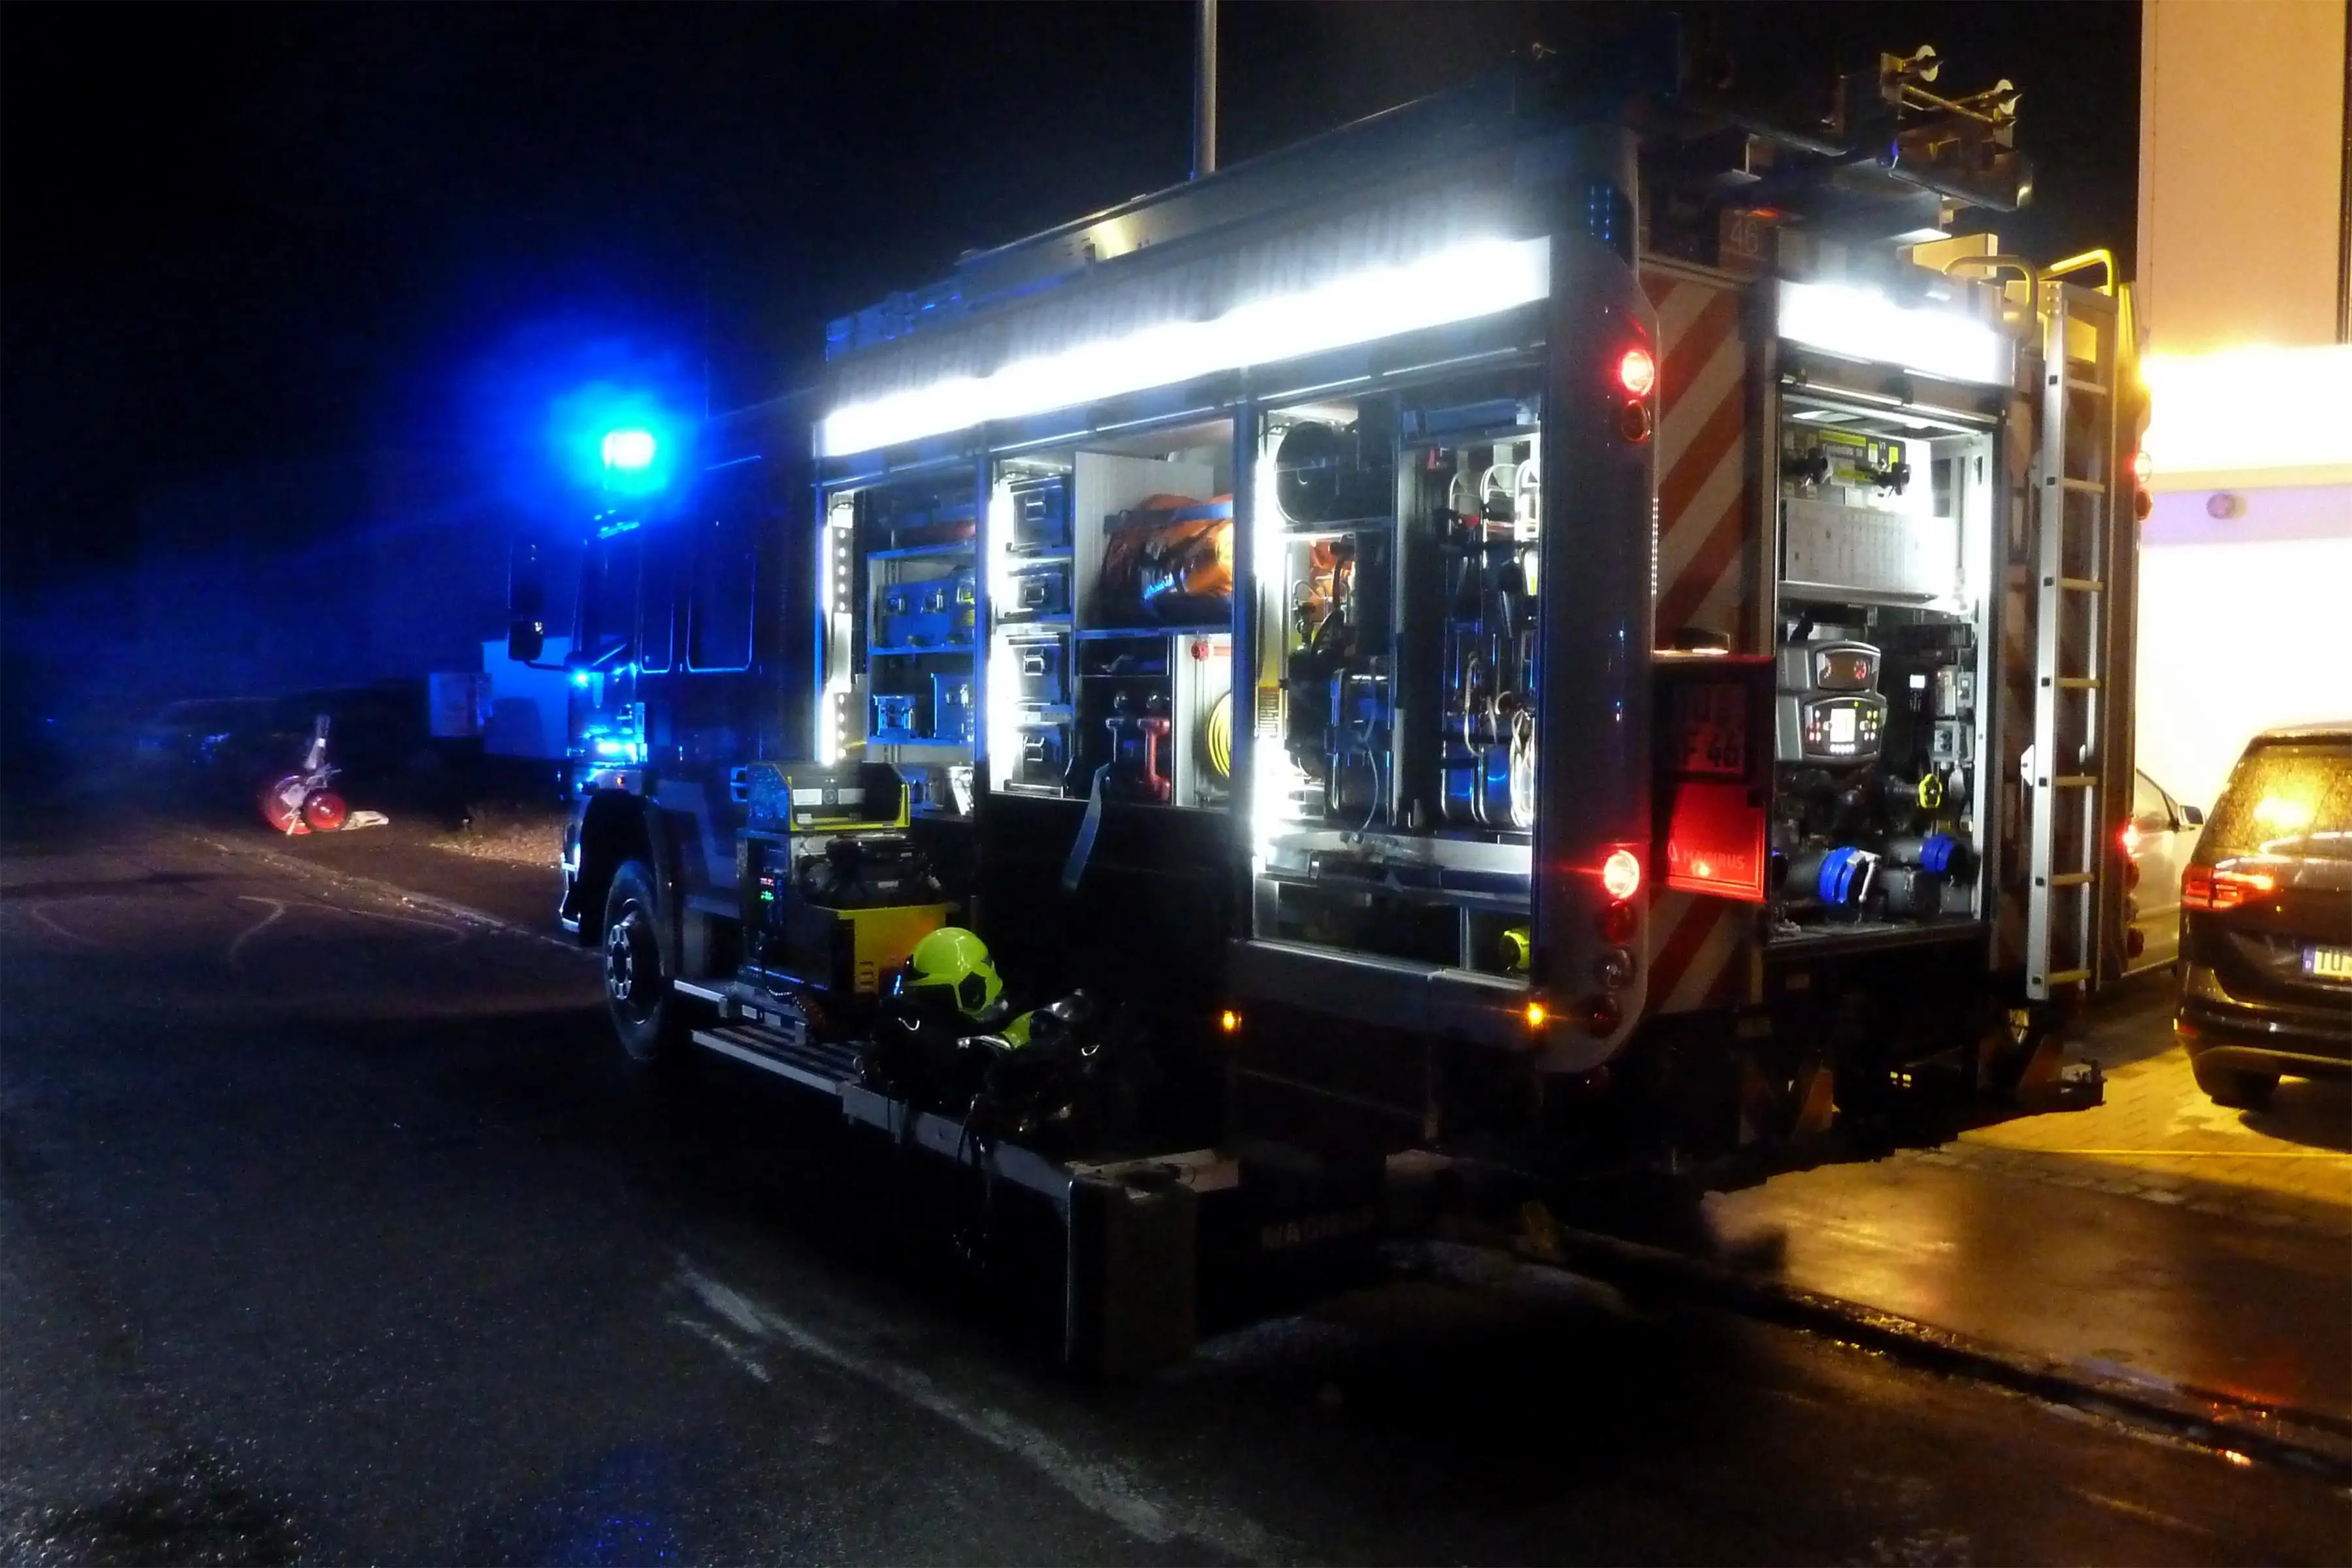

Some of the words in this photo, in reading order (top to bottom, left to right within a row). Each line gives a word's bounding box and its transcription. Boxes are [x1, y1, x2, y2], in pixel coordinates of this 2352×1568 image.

[1730, 218, 1758, 253] 46
[1707, 729, 1739, 768] 46
[1682, 849, 1746, 870] MAGIRUS
